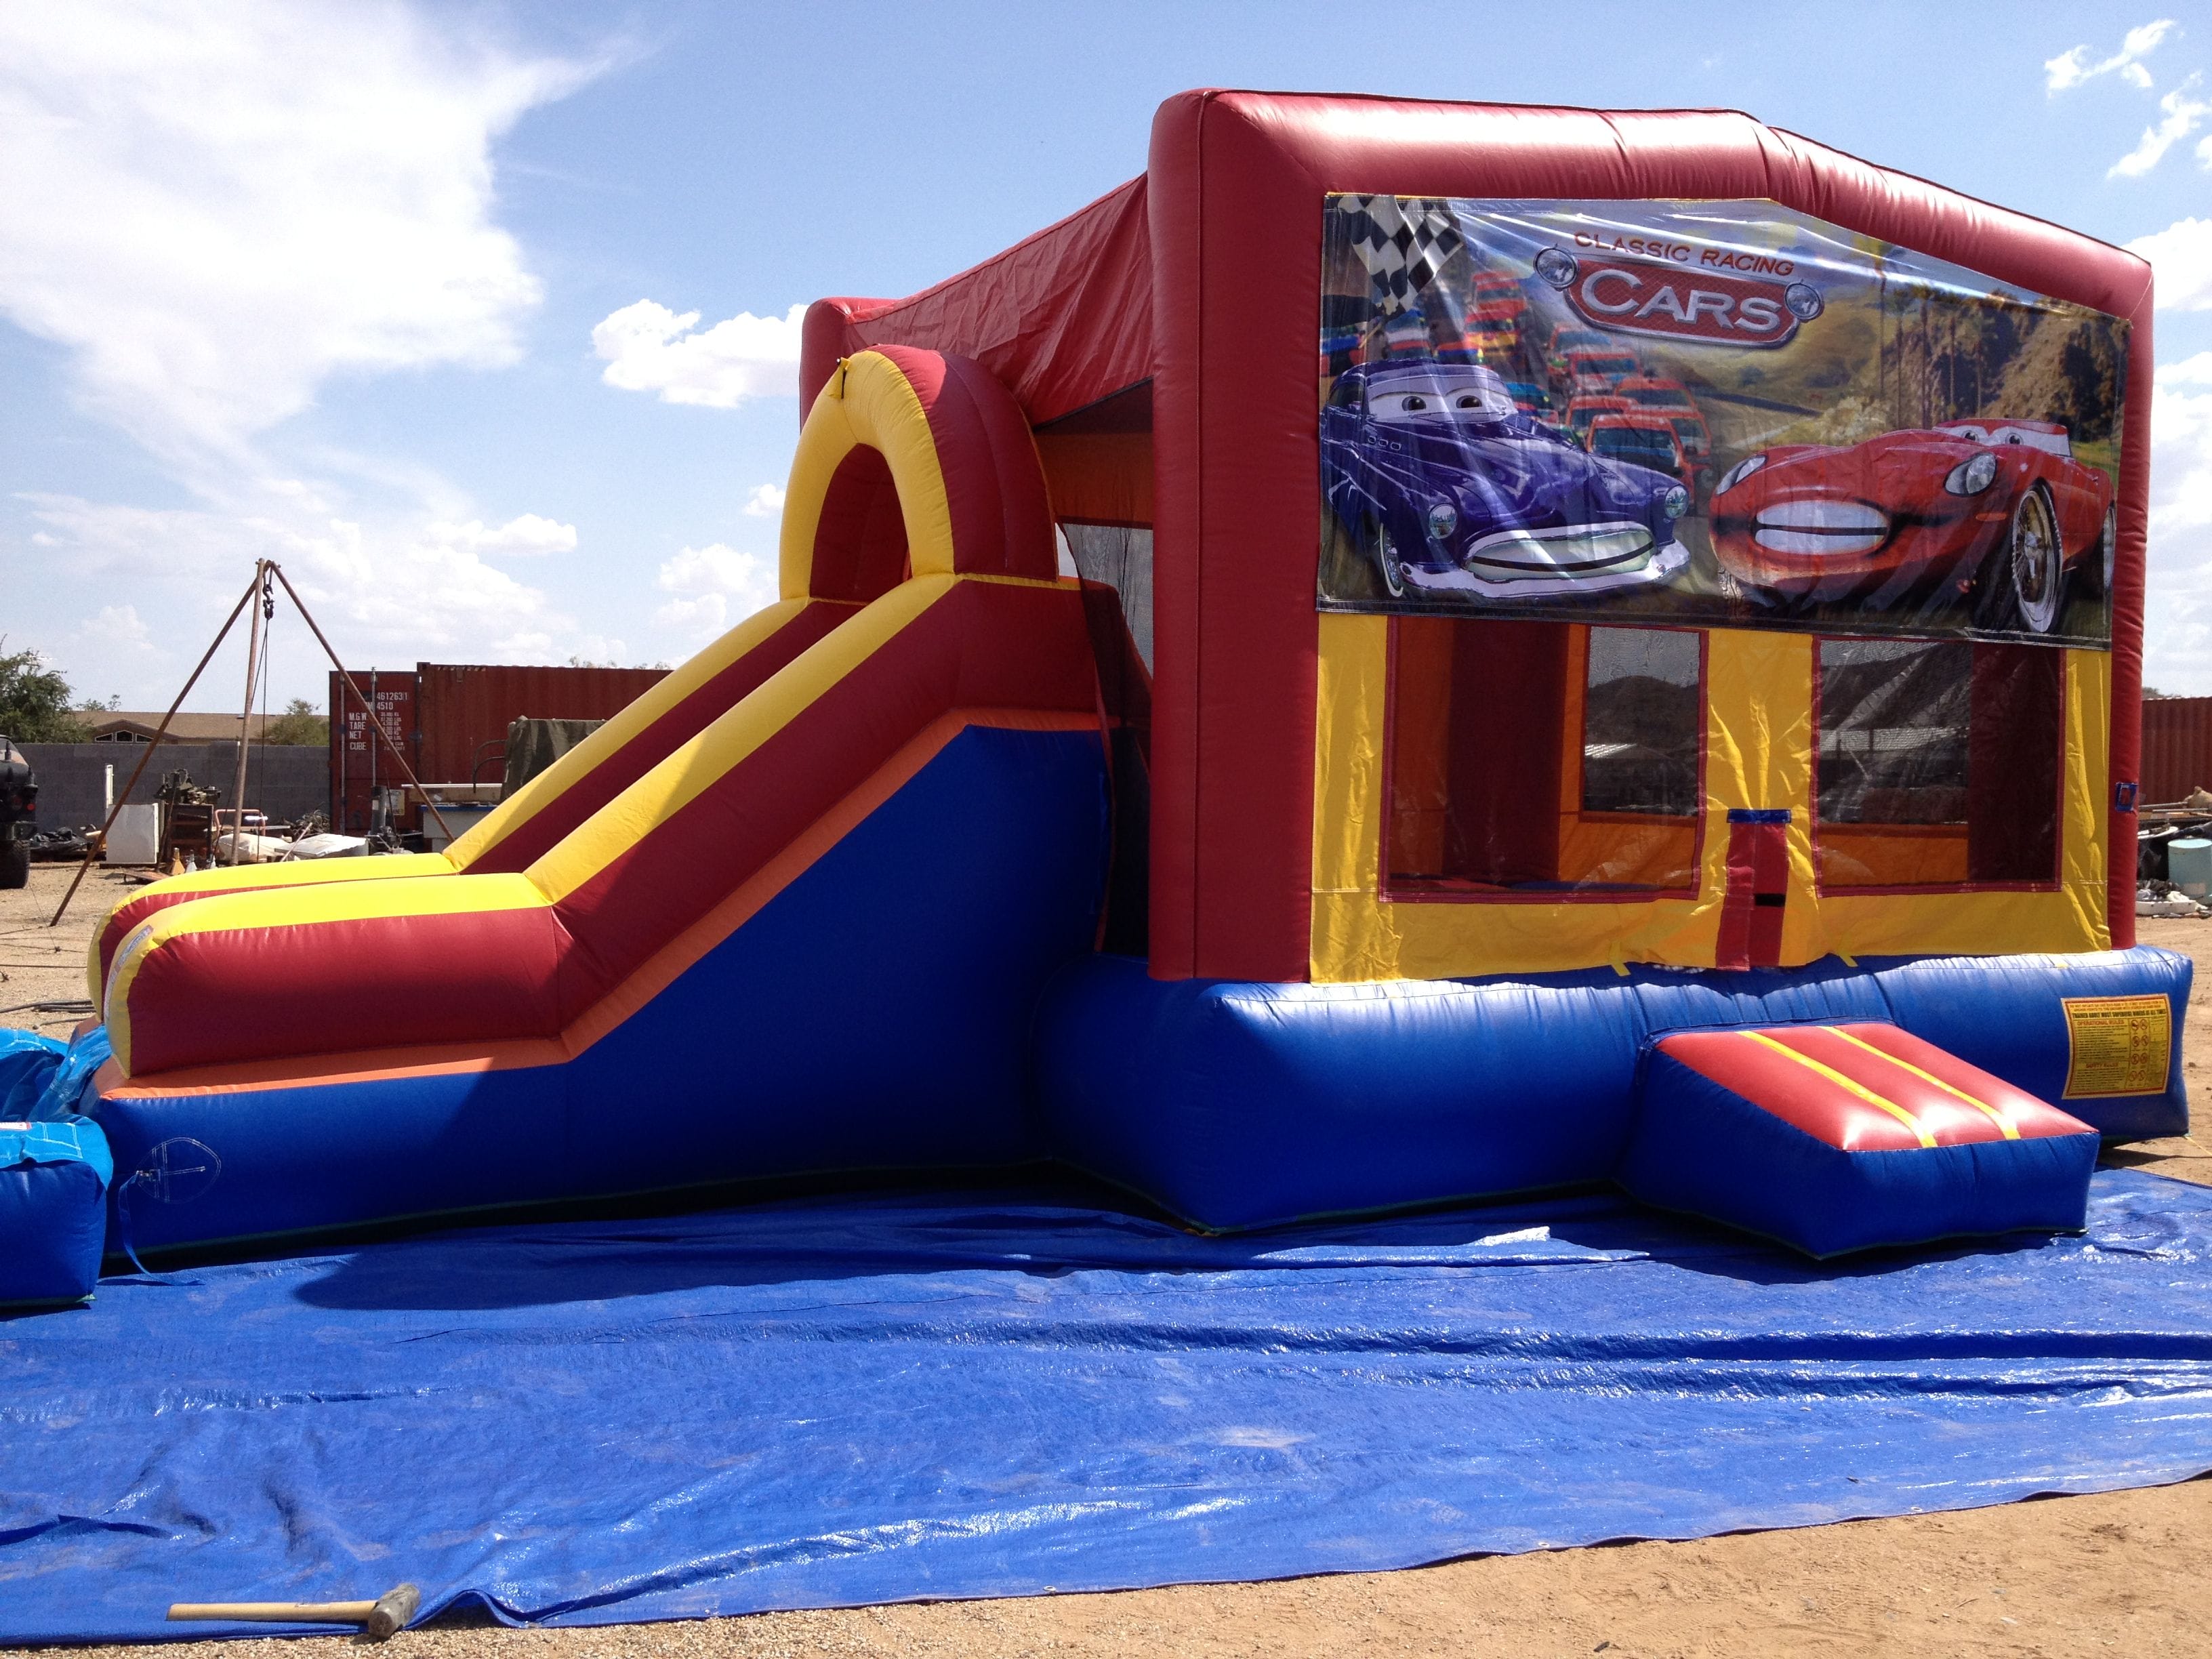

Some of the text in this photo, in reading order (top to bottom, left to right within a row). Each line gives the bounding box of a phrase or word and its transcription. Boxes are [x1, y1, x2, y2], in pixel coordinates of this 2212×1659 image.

[1574, 230, 1795, 276] CLASSIC RACING
[1581, 268, 1782, 333] CARS
[377, 701, 393, 710] 4510
[350, 722, 366, 730] TARE
[350, 741, 367, 750] CUBE
